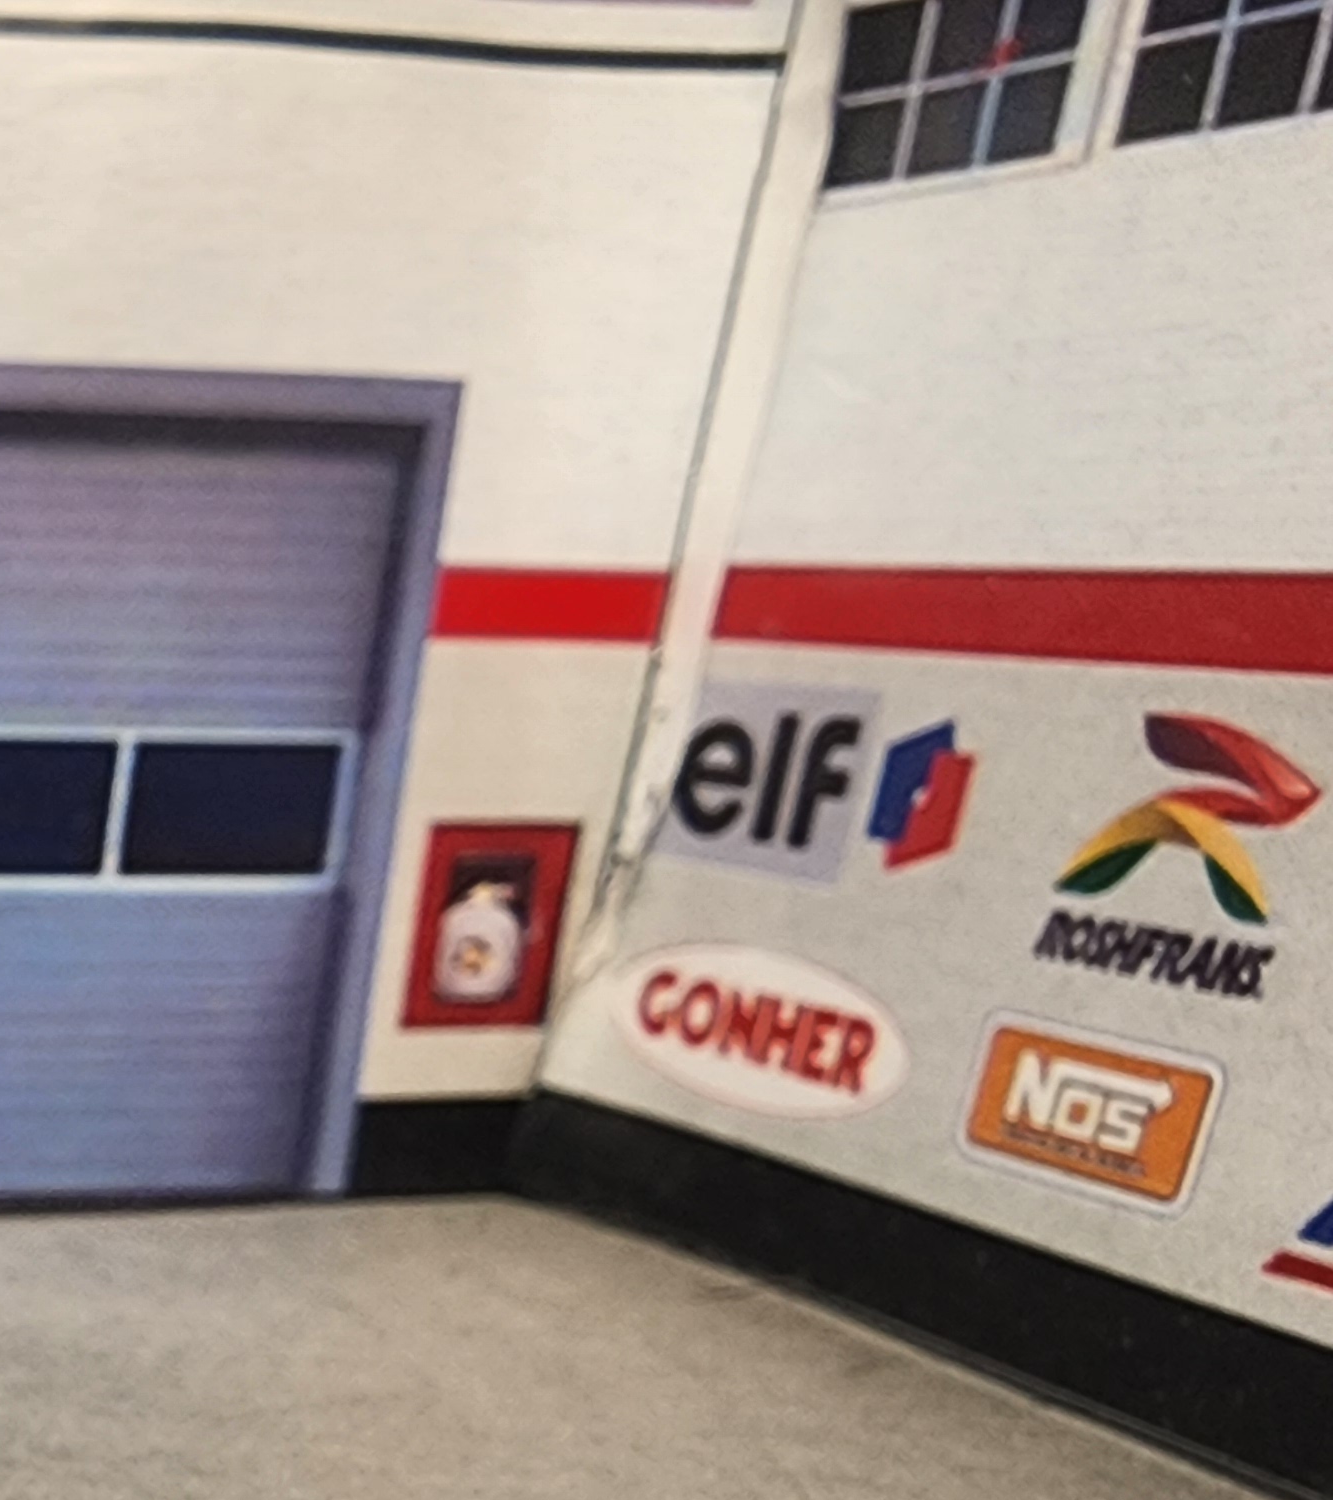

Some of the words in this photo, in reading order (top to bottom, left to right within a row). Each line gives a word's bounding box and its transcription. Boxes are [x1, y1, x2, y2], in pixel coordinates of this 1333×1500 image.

[671, 711, 861, 850] elf
[1034, 909, 1275, 1001] ROSHFRANS
[637, 970, 874, 1094] CONHER
[1004, 1048, 1173, 1154] NOS
